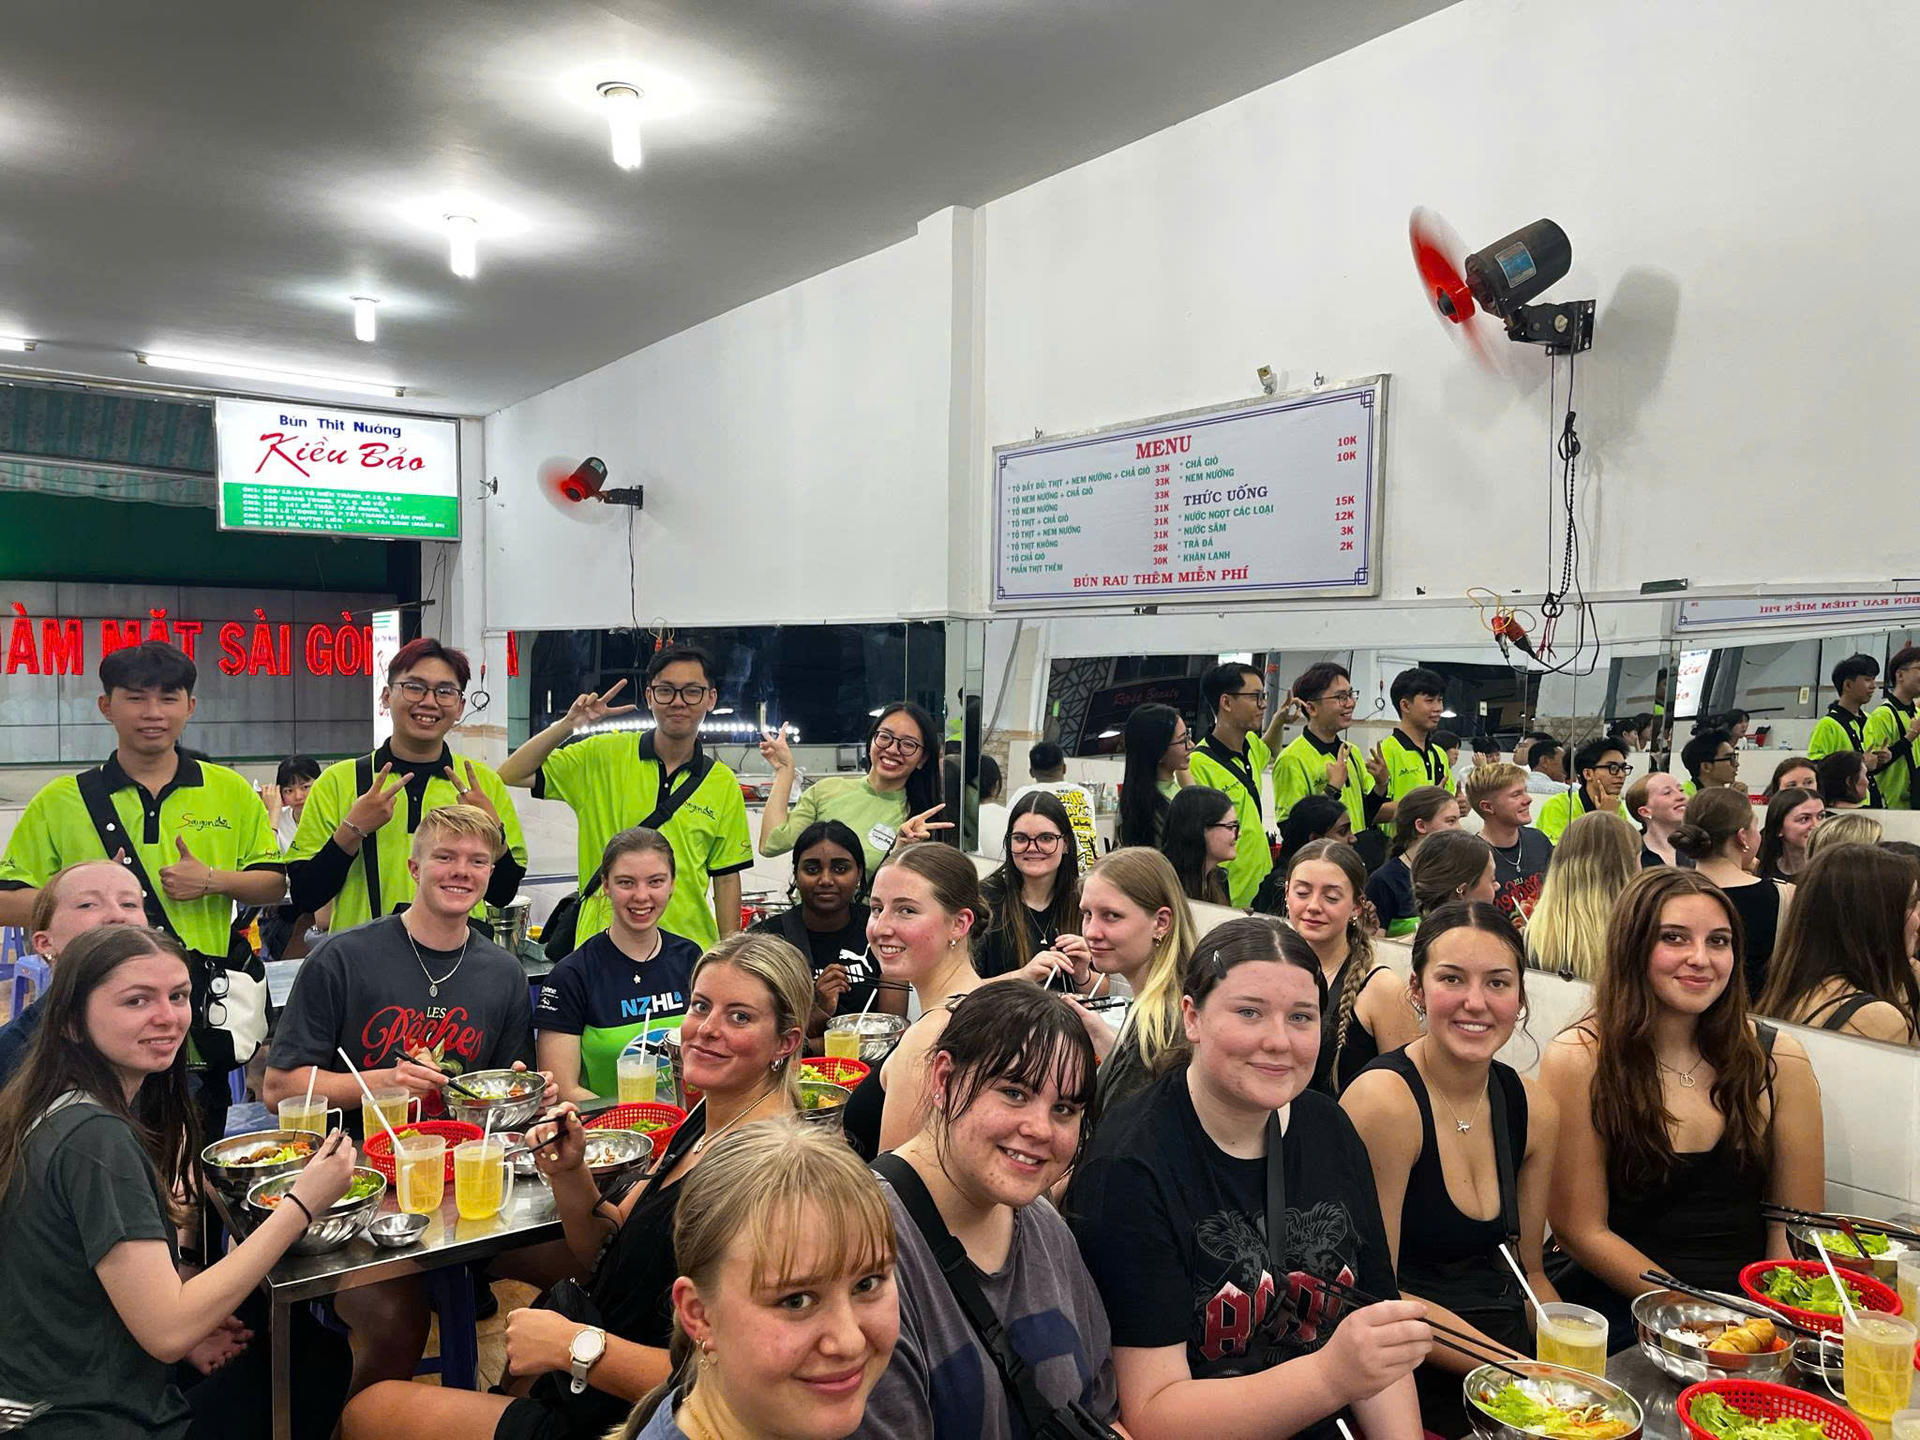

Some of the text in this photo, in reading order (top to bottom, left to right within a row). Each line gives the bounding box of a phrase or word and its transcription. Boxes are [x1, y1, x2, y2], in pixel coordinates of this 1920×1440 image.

[1135, 435, 1192, 460] MENU
[1185, 456, 1202, 469] CHẢ
[1337, 435, 1357, 447] 10K
[1185, 472, 1203, 483] NEM
[1337, 450, 1357, 462] 10K
[1071, 476, 1086, 485] NEM
[1155, 463, 1170, 474] 33K
[1154, 477, 1170, 487] 33K
[1154, 490, 1170, 500] 33K
[1183, 483, 1268, 506] THỨC UỐNG
[1154, 503, 1169, 513] 31K
[1233, 506, 1251, 517] CÁC
[1335, 495, 1355, 506] 15K
[1154, 516, 1169, 526] 31K
[1335, 510, 1355, 521] 12K
[1153, 530, 1169, 540] 31K
[1340, 526, 1354, 536] 3K
[1153, 543, 1168, 553] 28K
[1339, 541, 1354, 551] 2K
[1153, 556, 1168, 566] 30K
[1073, 565, 1250, 588] BÚN RAU THÊM MIỄN PHÍ
[0, 602, 84, 676] ÀM
[218, 608, 291, 676] SÀI
[427, 1006, 447, 1019] LES
